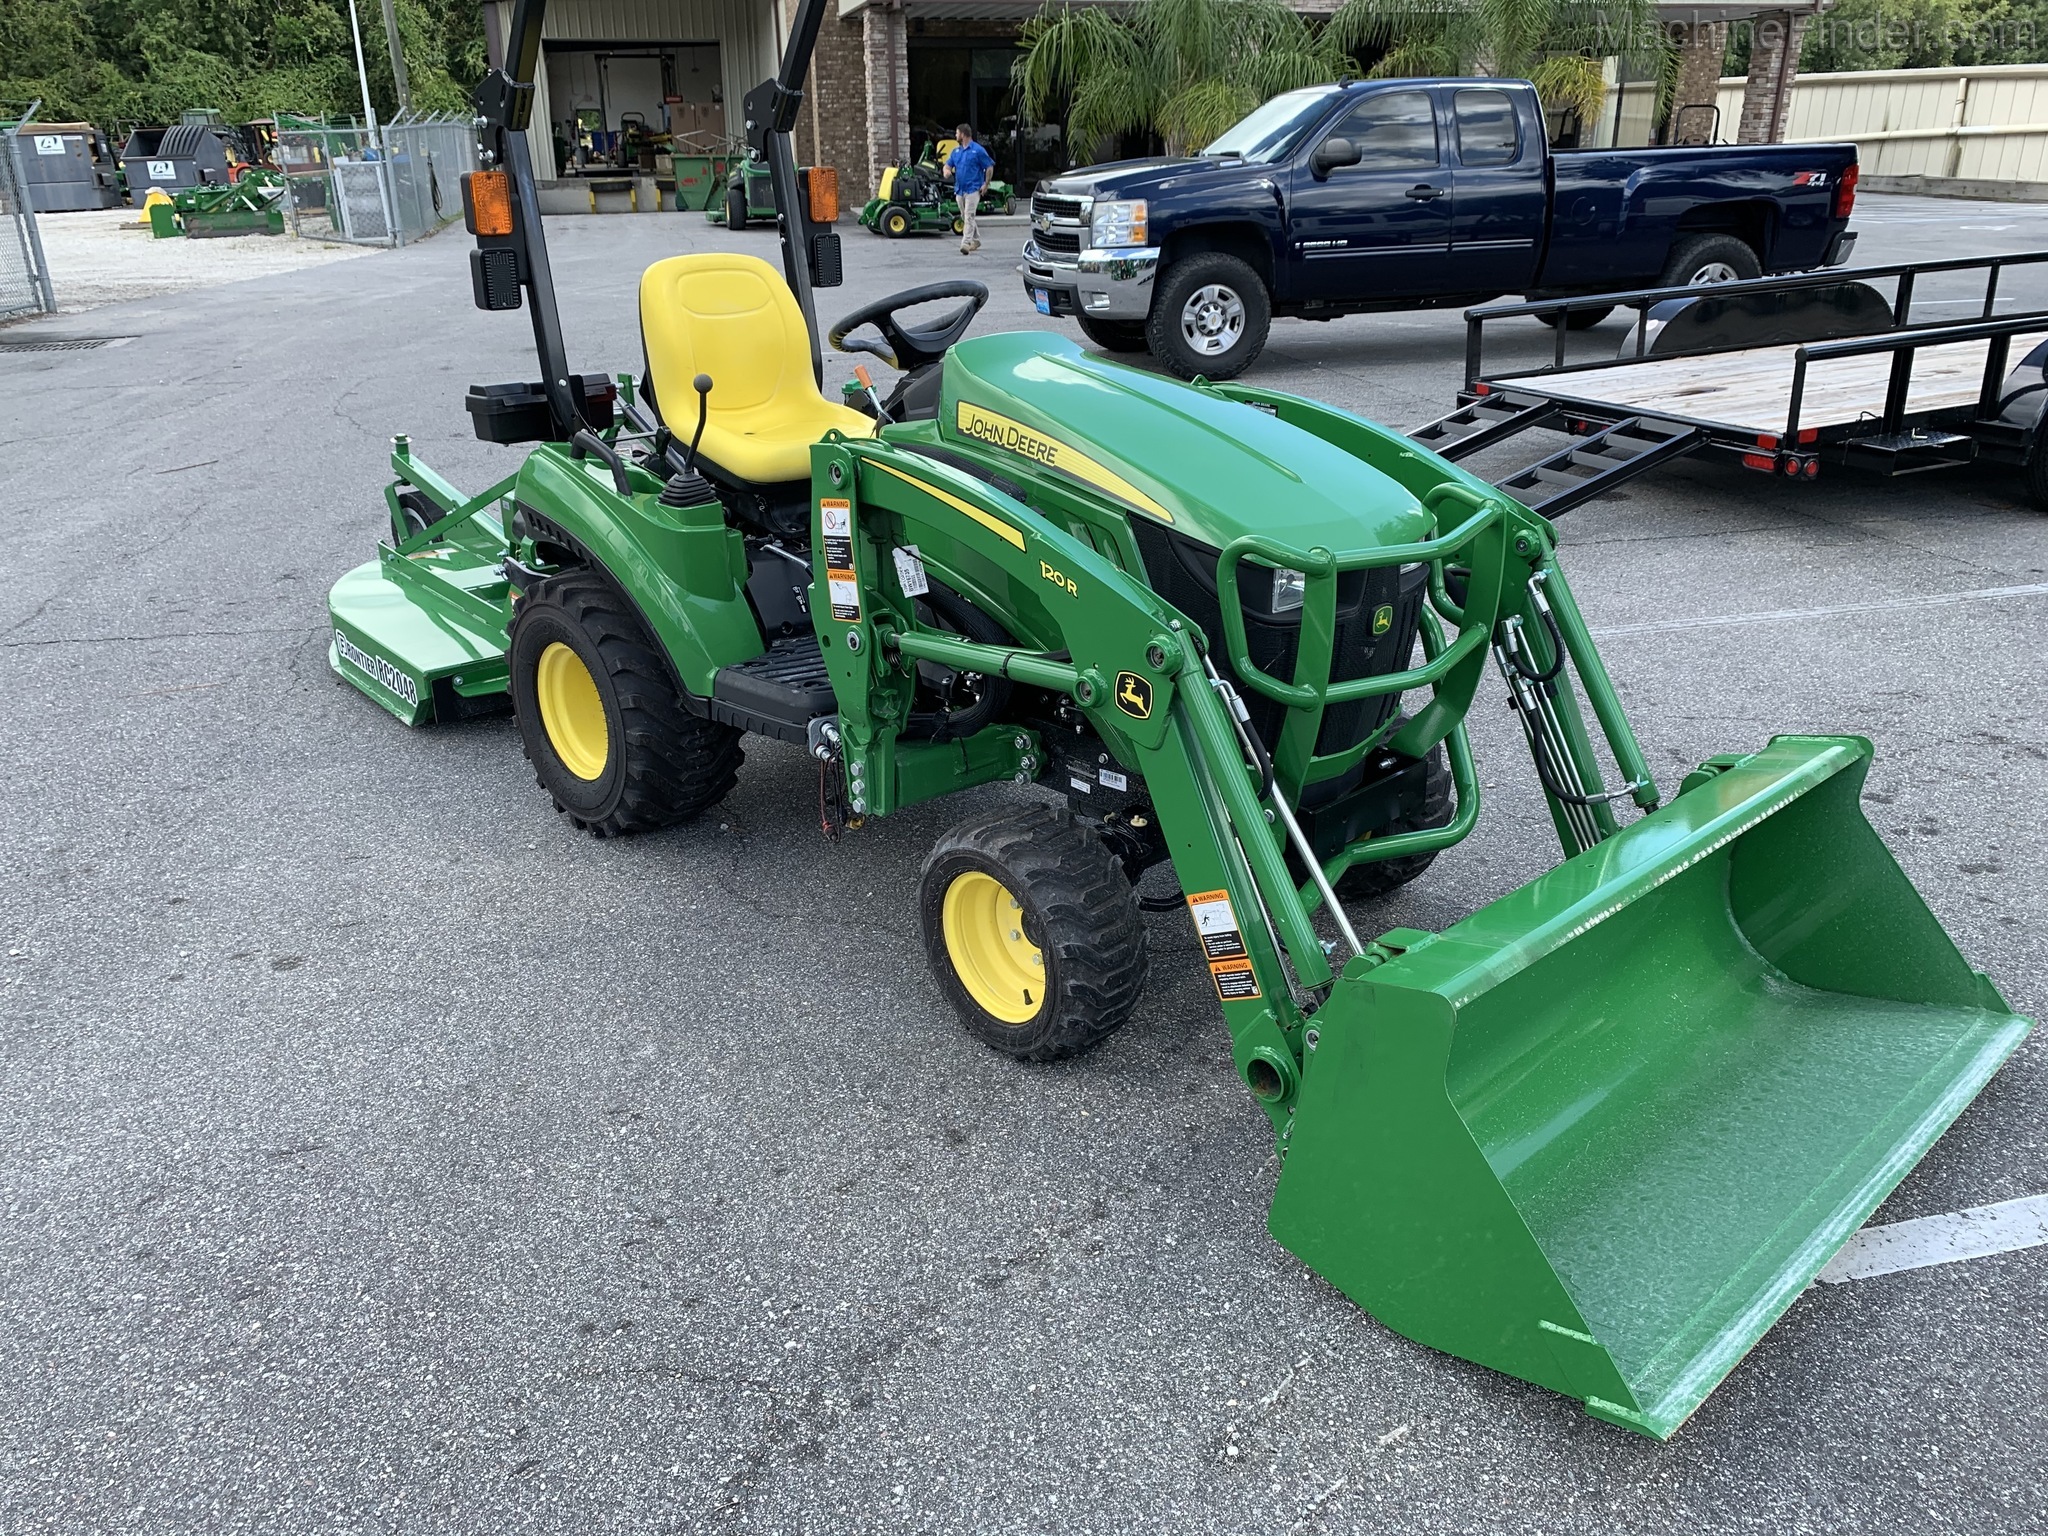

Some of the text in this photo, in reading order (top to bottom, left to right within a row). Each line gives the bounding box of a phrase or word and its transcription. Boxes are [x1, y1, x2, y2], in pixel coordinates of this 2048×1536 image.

[964, 413, 1058, 464] JOHN DEERE
[336, 630, 417, 706] FRONTIER RC2048
[1197, 893, 1224, 902] WARNING
[1221, 962, 1248, 971] WARNING
